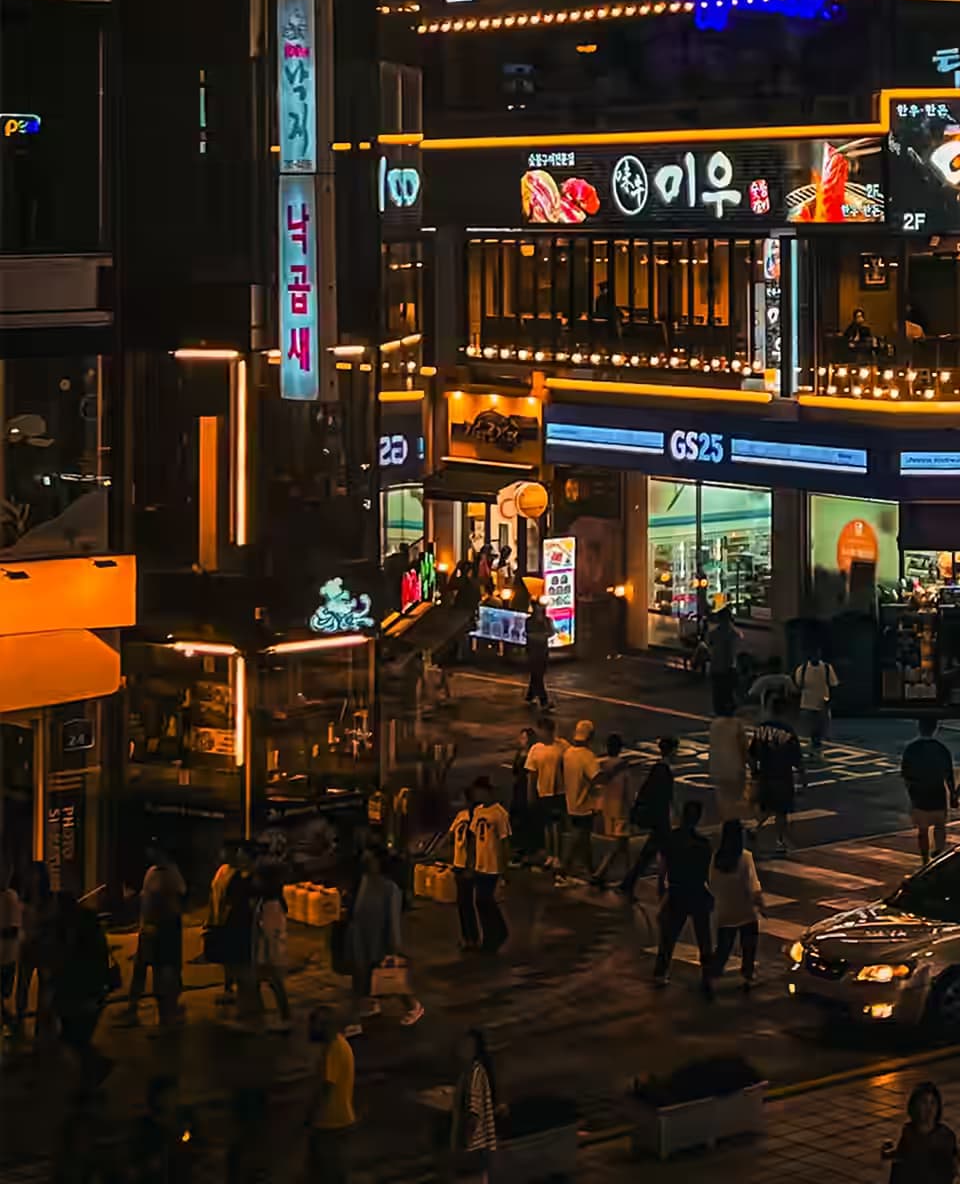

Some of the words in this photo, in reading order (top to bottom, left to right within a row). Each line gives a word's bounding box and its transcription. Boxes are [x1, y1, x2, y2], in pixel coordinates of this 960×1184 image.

[655, 151, 741, 218] 미우
[903, 213, 926, 231] 2F
[287, 202, 311, 372] 낙곱새
[670, 430, 724, 463] GS25
